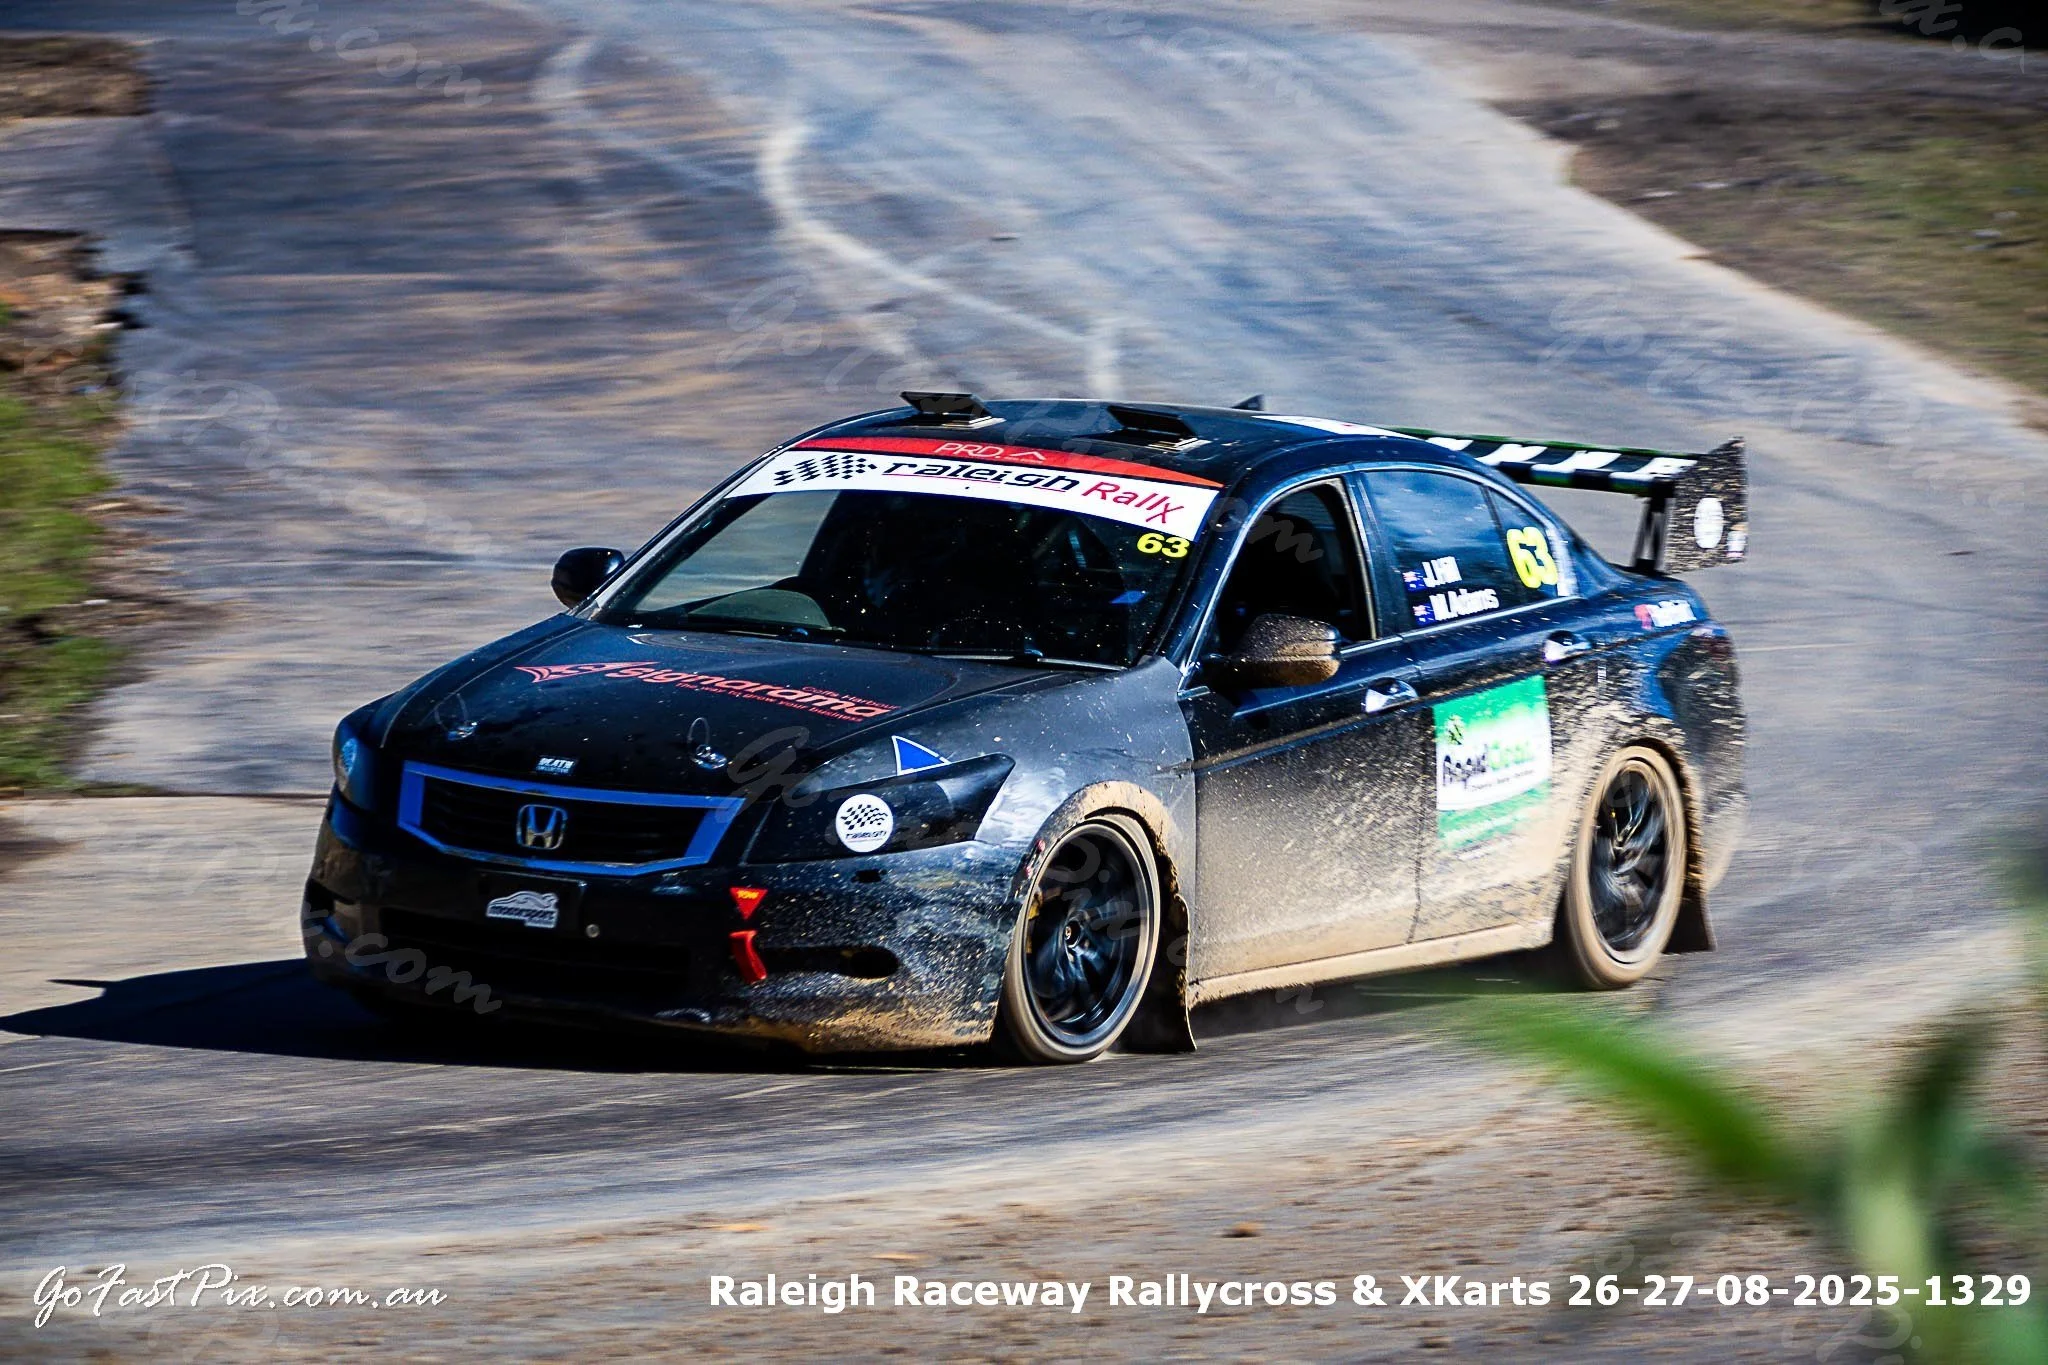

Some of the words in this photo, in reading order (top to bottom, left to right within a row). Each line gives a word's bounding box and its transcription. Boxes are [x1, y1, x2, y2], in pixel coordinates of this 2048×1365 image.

[882, 462, 1080, 491] raleigh
[1136, 532, 1190, 558] 63
[1506, 526, 1559, 588] 63
[736, 889, 760, 900] TOW
